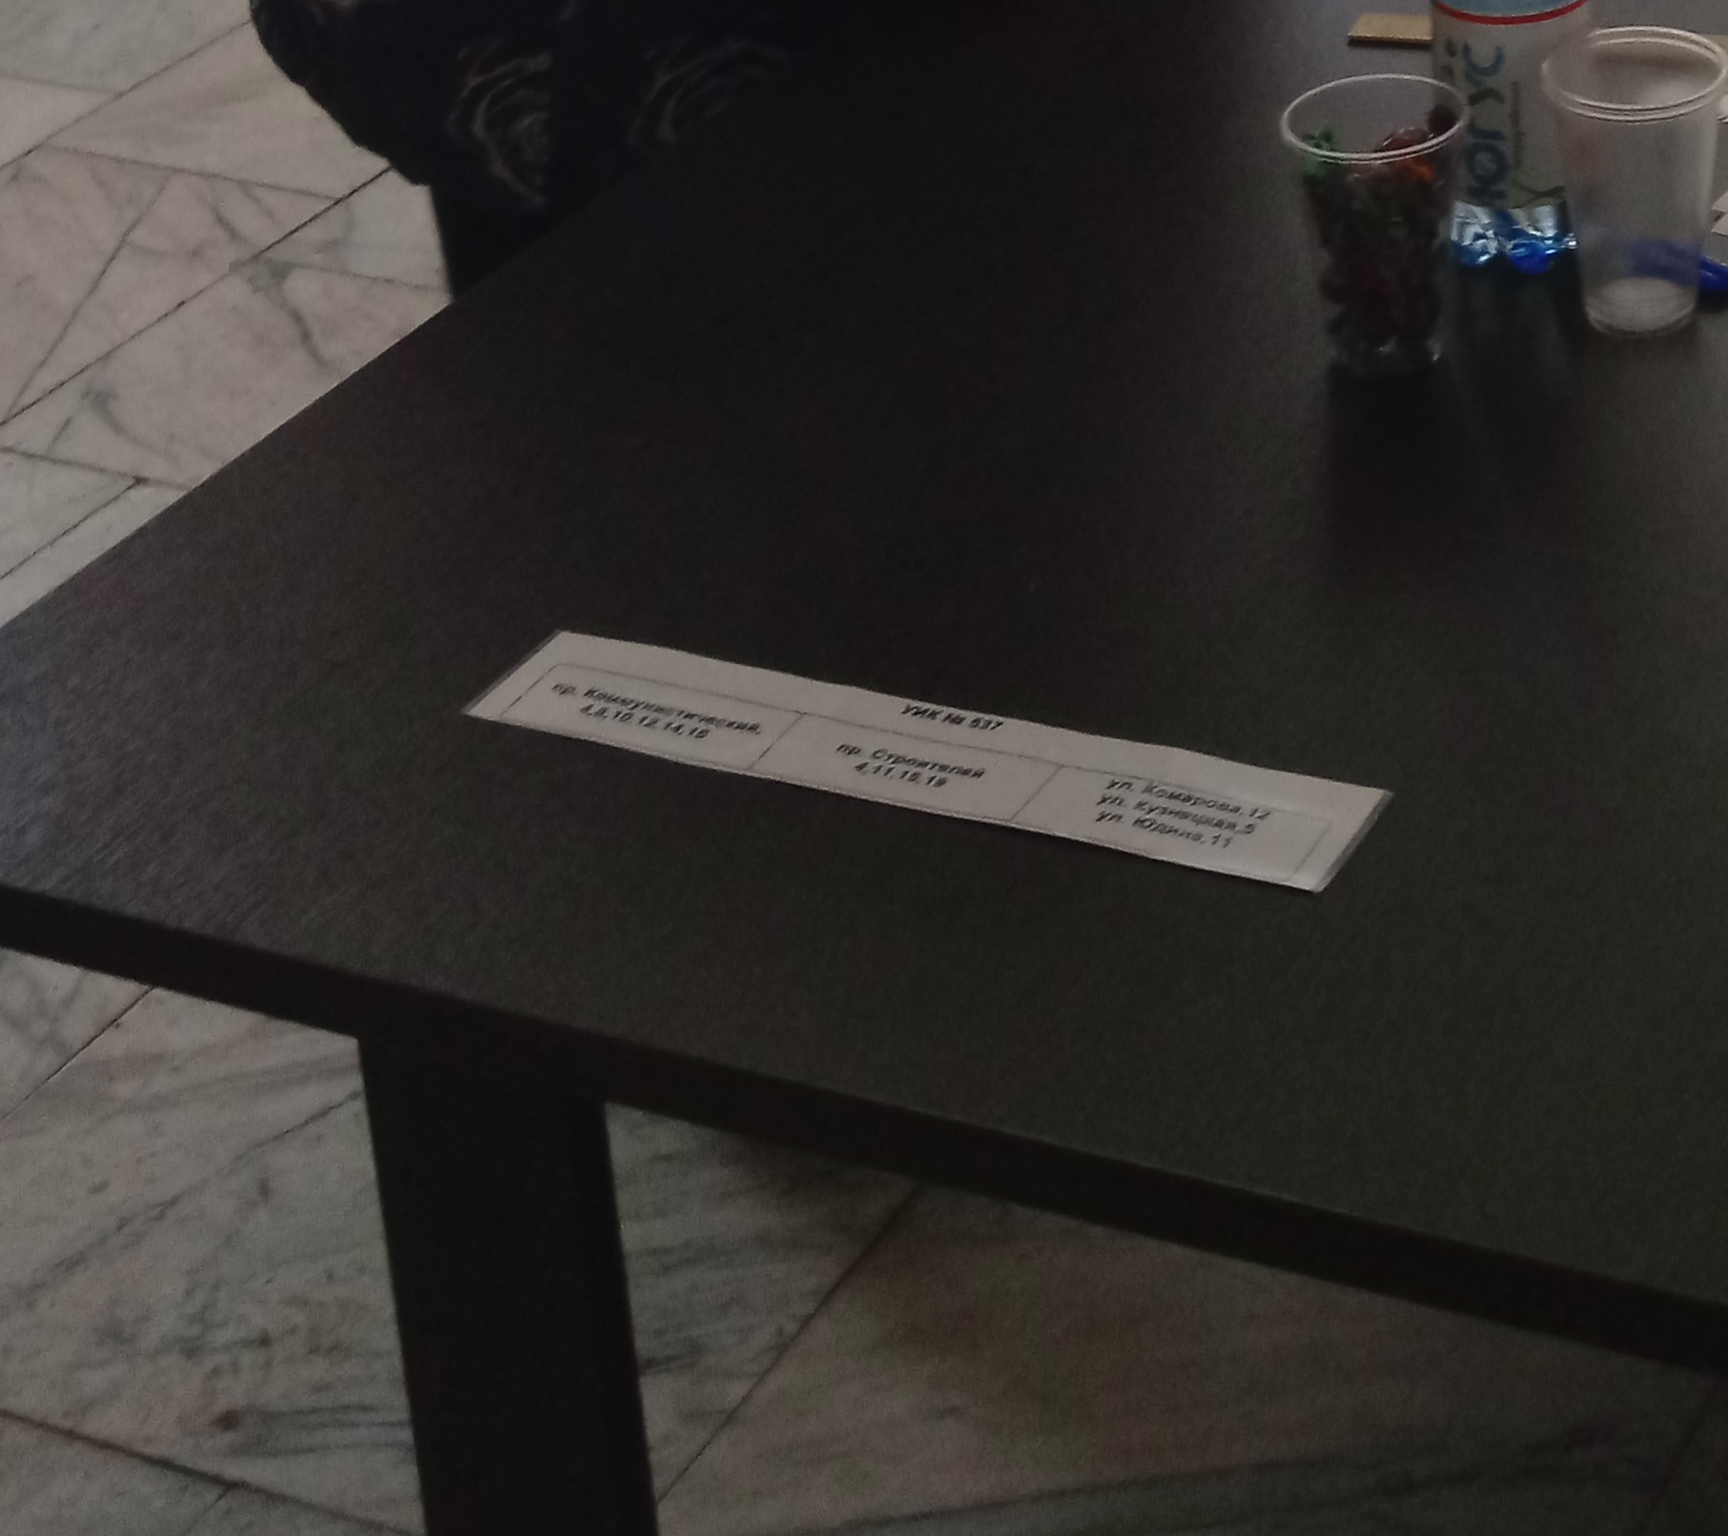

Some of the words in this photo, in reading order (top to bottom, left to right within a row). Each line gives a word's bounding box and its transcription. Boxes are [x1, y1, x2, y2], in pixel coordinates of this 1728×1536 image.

[901, 703, 940, 721] УИК
[871, 747, 987, 780] Строителей
[1141, 781, 1243, 816] Комарова,
[1248, 806, 1273, 821] 12
[1211, 833, 1235, 849] 11
